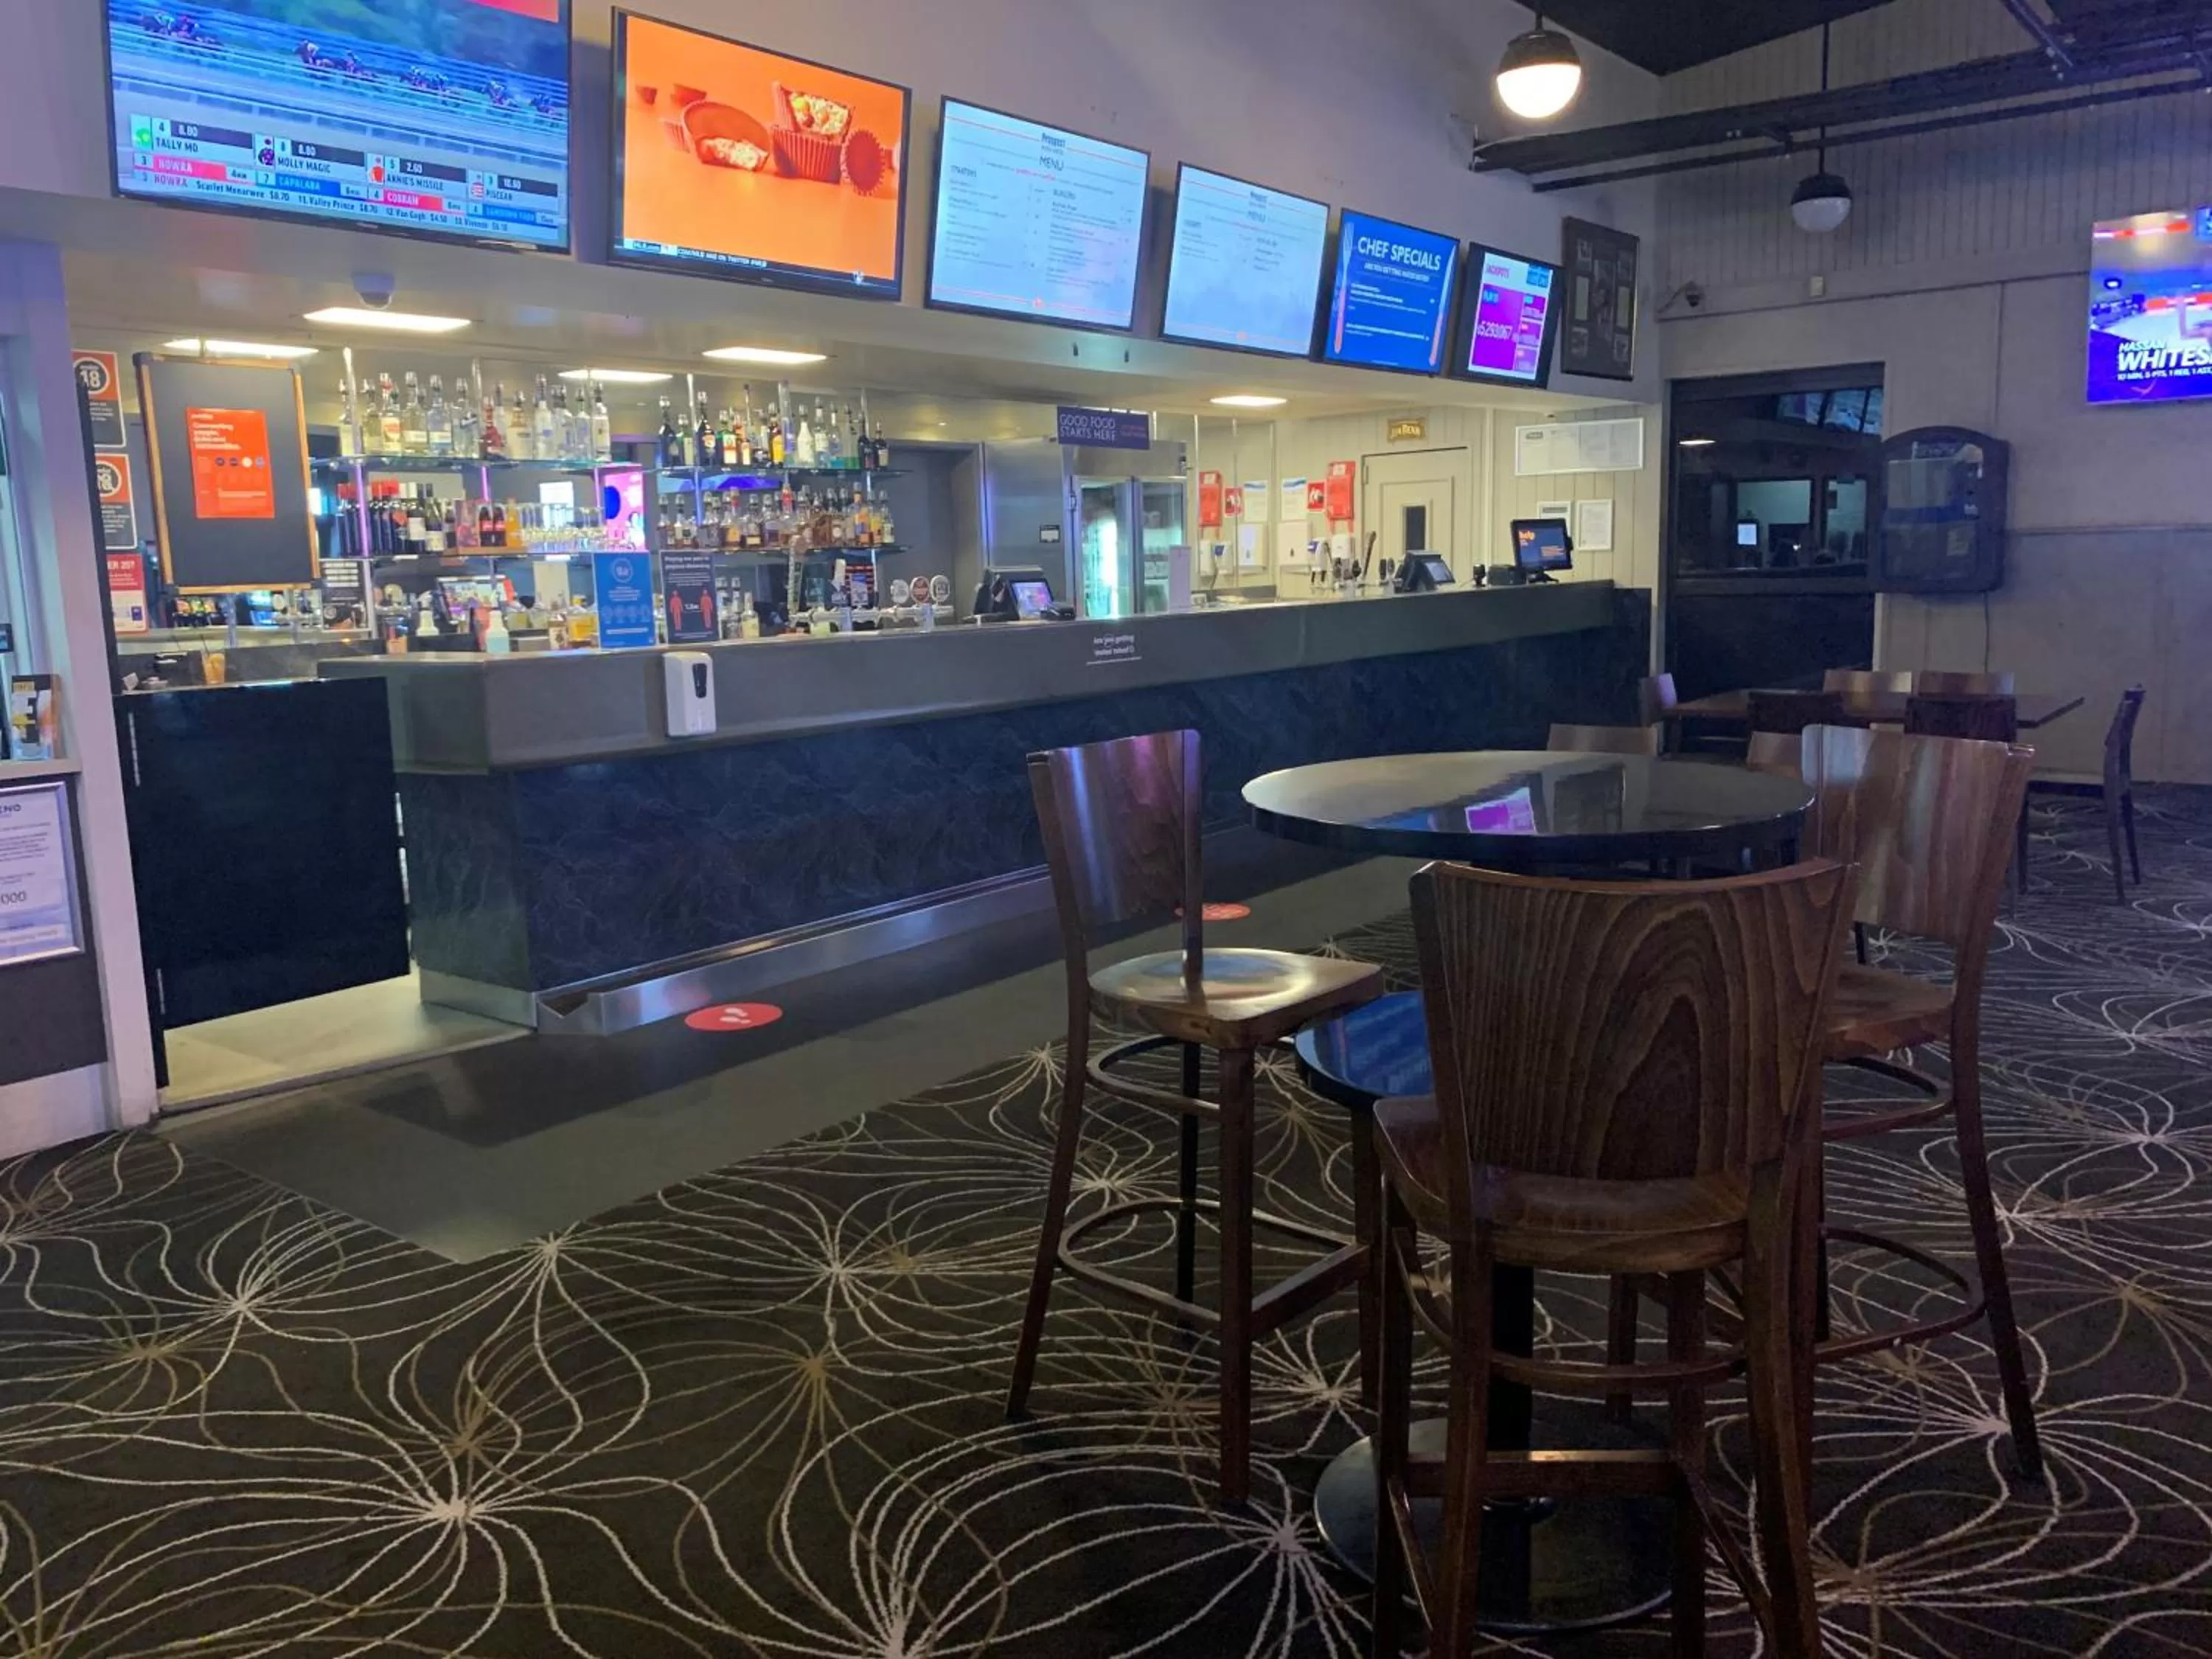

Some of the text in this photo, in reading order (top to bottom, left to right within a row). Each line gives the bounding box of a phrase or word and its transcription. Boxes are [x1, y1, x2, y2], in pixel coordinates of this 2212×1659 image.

[1357, 236, 1441, 271] CHEF SPECIALS
[2118, 346, 2212, 371] WHITES
[1060, 414, 1116, 429] GOOD FOOD
[1060, 426, 1116, 442] STARTS HERE
